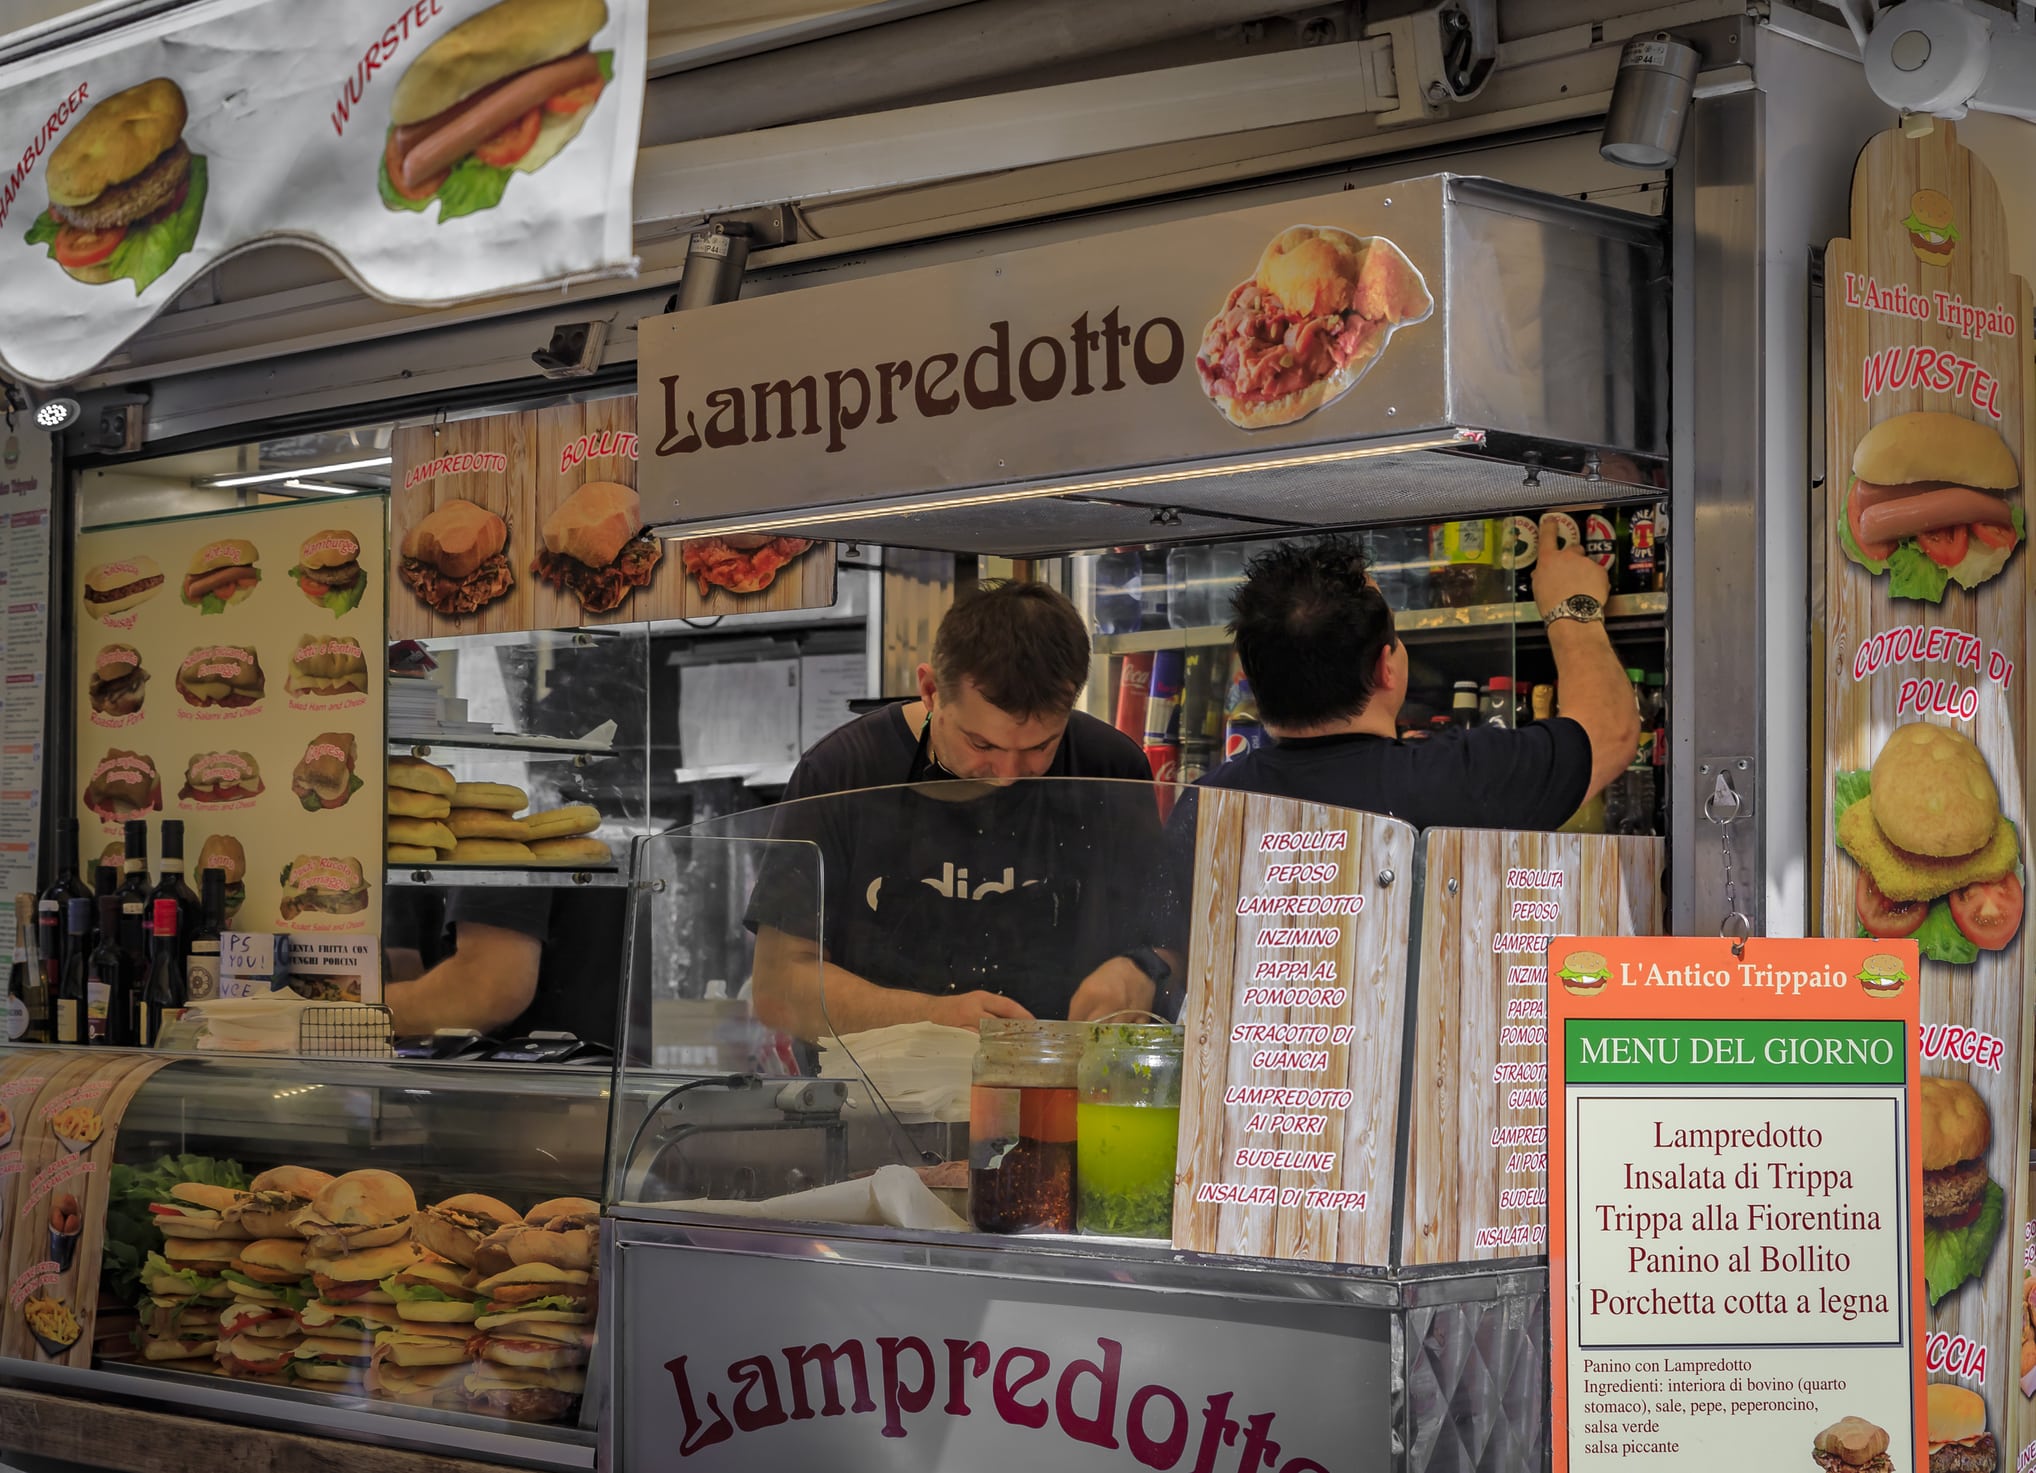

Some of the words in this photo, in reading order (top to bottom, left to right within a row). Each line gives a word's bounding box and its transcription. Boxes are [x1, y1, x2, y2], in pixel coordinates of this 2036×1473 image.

[331, 0, 443, 137] WURSTEL
[0, 81, 89, 229] HAMBURGER
[1845, 273, 1930, 320] L'Antico
[1933, 292, 2016, 337] Trippaio
[655, 304, 1184, 456] Lampredotto
[1863, 347, 2002, 419] WURSTEL
[405, 453, 507, 489] LAMPREDOTTO
[303, 536, 358, 557] Hamburger
[1854, 627, 1981, 679] COTOLETTA
[1988, 651, 2013, 688] DI
[1898, 678, 1979, 720] POLLO
[1261, 832, 1347, 851] RIBOLLITA
[1266, 864, 1337, 883] PEPOSO
[1507, 869, 1564, 887] RIBOLLITA
[1237, 896, 1363, 915] LAMPREDOTTO
[1512, 903, 1559, 919] PEPOSO
[1256, 929, 1339, 947] INZIMINO
[319, 944, 347, 954] FRITTA
[352, 945, 369, 954] CON
[323, 956, 358, 967] PORCINI
[1255, 963, 1309, 980] PAPPA
[1312, 963, 1337, 980] AL
[1620, 962, 1731, 988] L'Antico
[1738, 963, 1848, 994] Trippaio
[1244, 988, 1345, 1007] POMODORO
[1508, 1001, 1543, 1018] PAPPA
[1232, 1025, 1330, 1043] STRACOTTO
[1333, 1027, 1353, 1044] DI
[1580, 1037, 1679, 1064] MENU
[1690, 1037, 1755, 1064] DEL
[1764, 1037, 1894, 1064] GIORNO
[1253, 1052, 1328, 1070] GUANCIA
[1225, 1088, 1352, 1108] LAMPREDOTTO
[1246, 1116, 1266, 1133] AI
[1269, 1117, 1325, 1134] PORRI
[1653, 1122, 1823, 1155] Lampredotto
[1235, 1150, 1335, 1170] BUDELLINE
[1507, 1155, 1520, 1171] AI
[1624, 1163, 1726, 1190] Insalata
[1734, 1162, 1758, 1189] di
[1767, 1162, 1853, 1196] Trippa
[1198, 1185, 1276, 1205] INSALATA
[1281, 1188, 1302, 1206] DI
[1306, 1190, 1367, 1210] TRIPPA
[1596, 1205, 1682, 1239] Trippa
[1692, 1204, 1738, 1230] alla
[1747, 1204, 1881, 1230] Fiorentina
[1476, 1228, 1529, 1246] INSALATA
[1533, 1226, 1546, 1242] DI
[1628, 1246, 1719, 1273] Panino
[1728, 1246, 1750, 1272] al
[1760, 1245, 1851, 1272] Bollito
[1590, 1289, 1715, 1315] Porchetta
[1724, 1291, 1788, 1315] cotta
[1797, 1297, 1811, 1314] a
[1819, 1288, 1889, 1320] legna
[1584, 1359, 1631, 1373] Panino
[1635, 1362, 1660, 1373] con
[1664, 1358, 1752, 1376] Lampredotto
[1584, 1379, 1663, 1396] Ingredienti:
[1668, 1378, 1726, 1392] interiora
[1729, 1378, 1742, 1391] di
[1747, 1378, 1794, 1391] bovino
[1798, 1377, 1847, 1393] (quarto
[1584, 1399, 1651, 1414] stomaco),
[1655, 1399, 1686, 1413] sale,
[1690, 1402, 1727, 1416] pepe,
[1731, 1397, 1819, 1416] peperoncino,
[1584, 1420, 1618, 1434] salsa
[1622, 1419, 1660, 1433] verde
[1584, 1440, 1618, 1454] salsa
[1622, 1440, 1680, 1457] piccante
